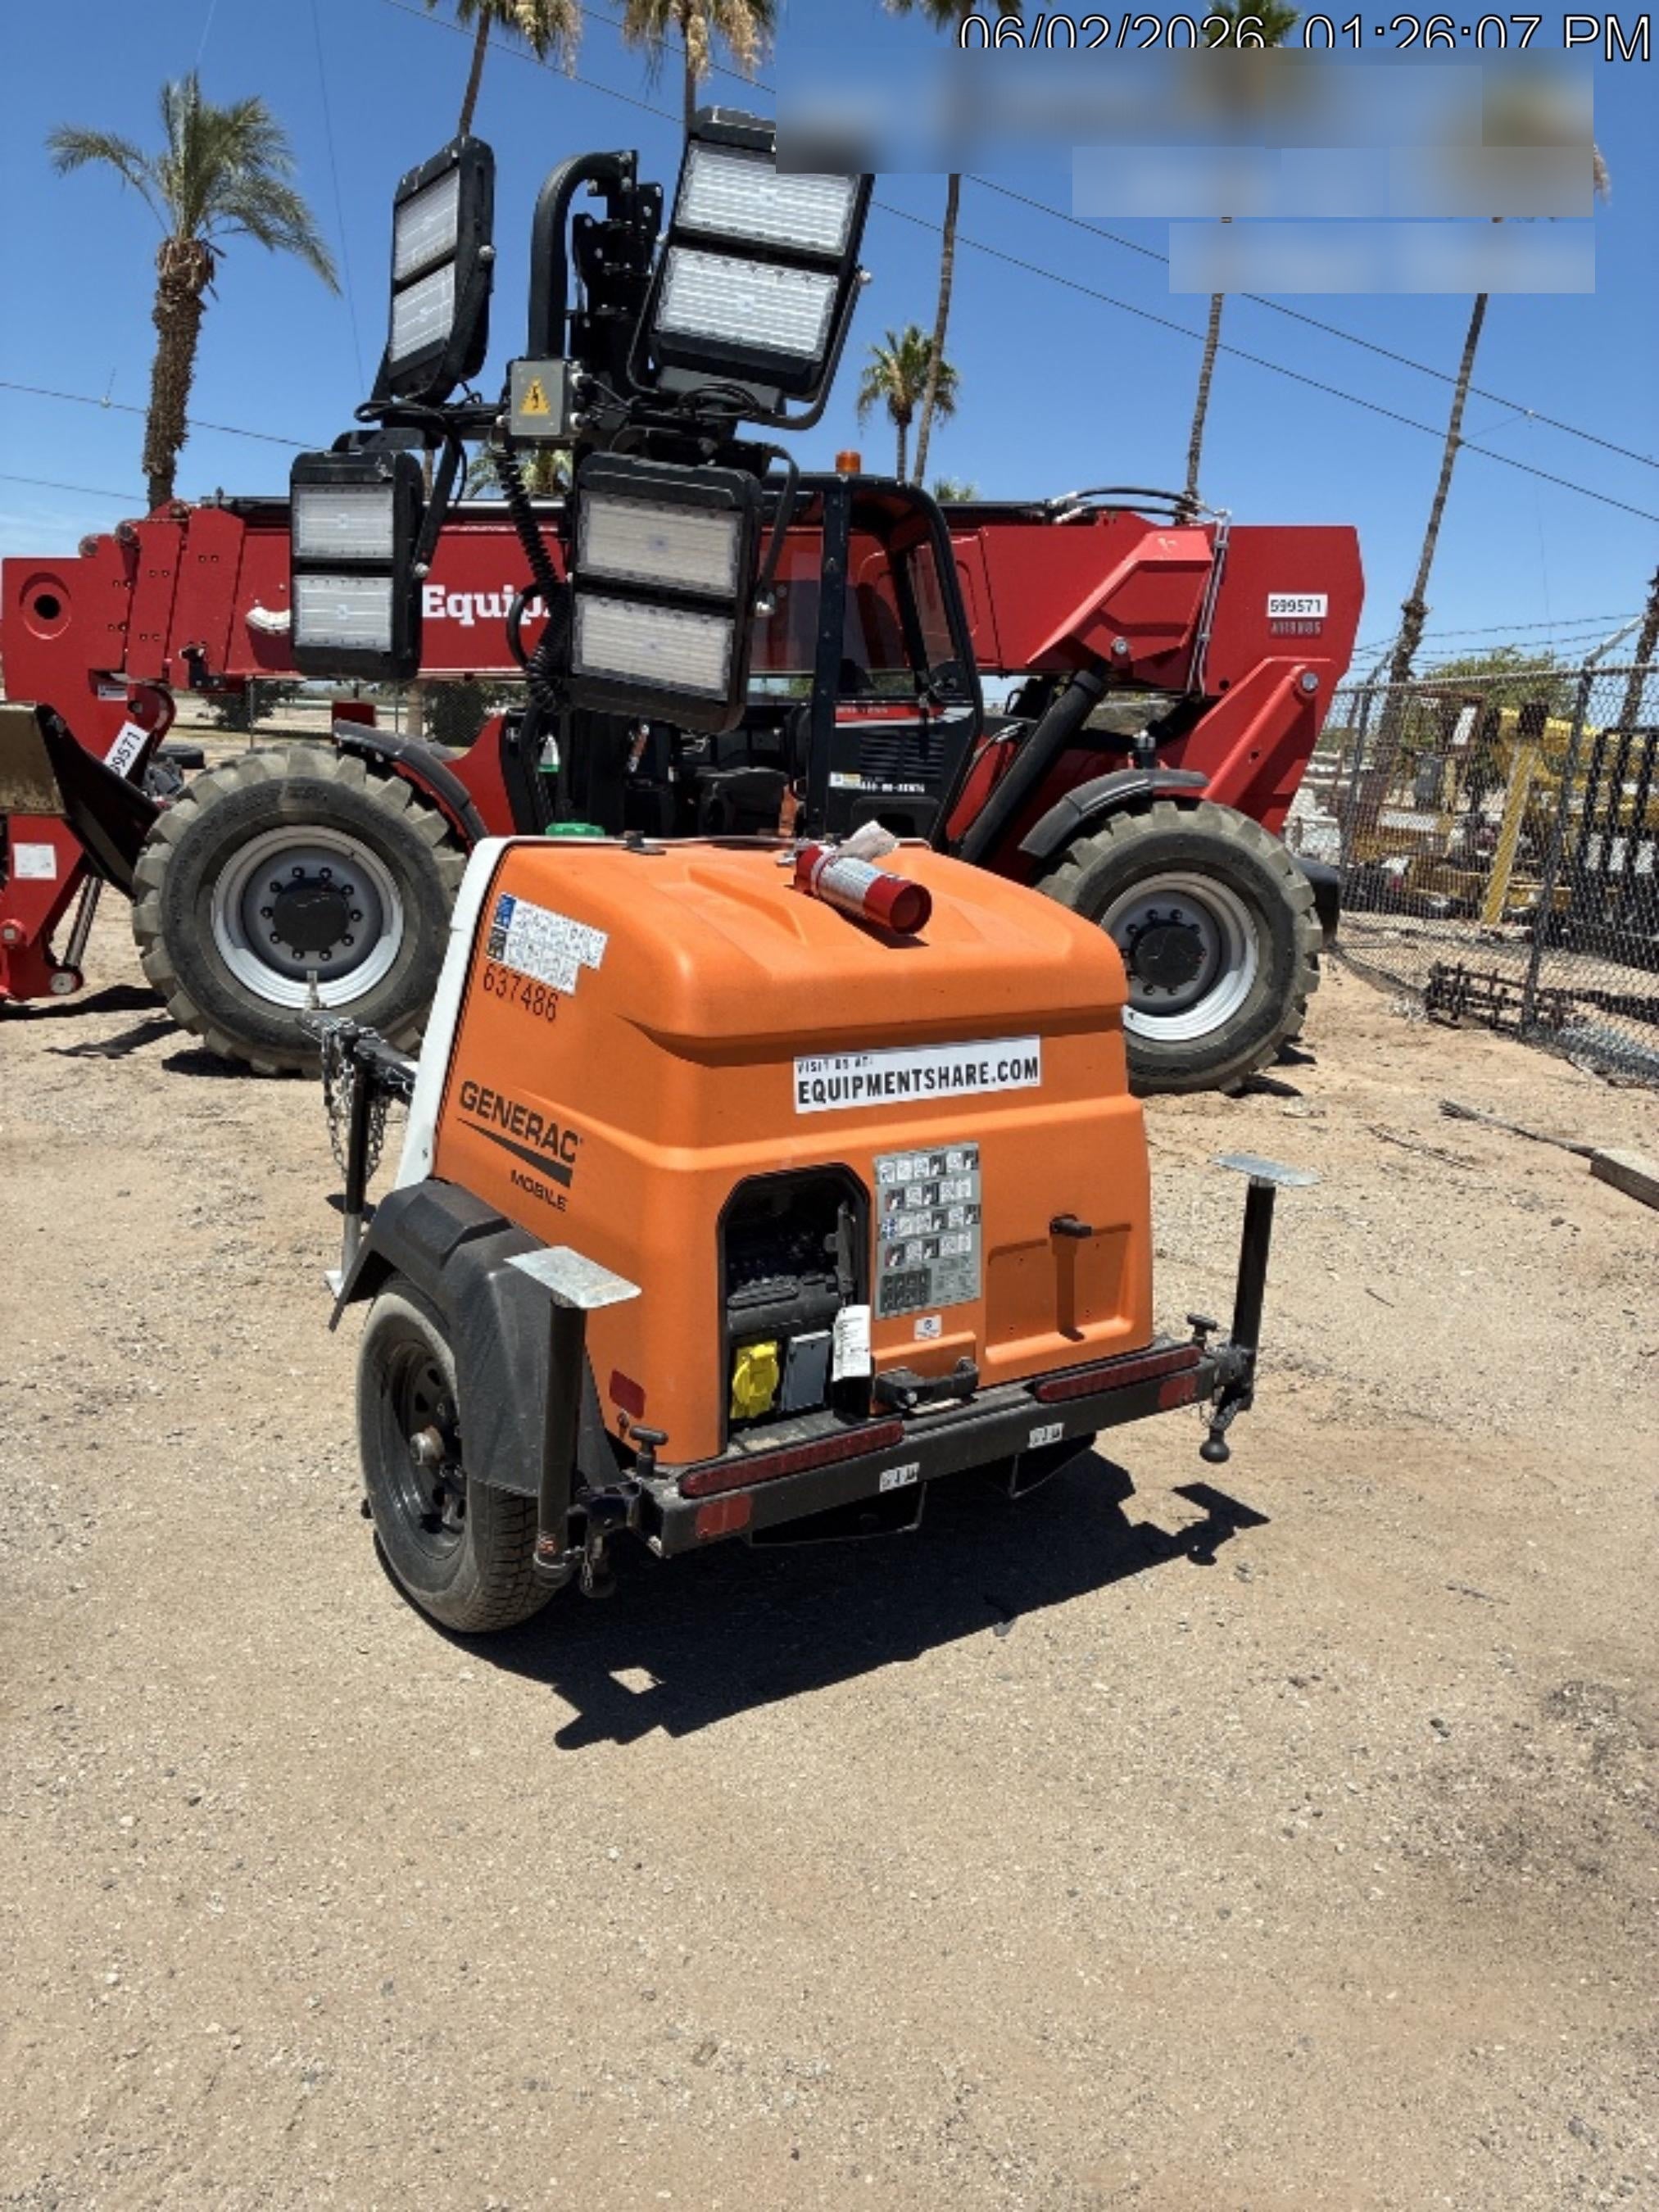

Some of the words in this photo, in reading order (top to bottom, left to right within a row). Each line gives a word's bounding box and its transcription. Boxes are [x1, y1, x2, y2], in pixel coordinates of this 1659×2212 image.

[422, 584, 551, 626] Equip
[1270, 599, 1321, 613] 599571
[483, 963, 559, 1022] 637486
[798, 1058, 829, 1074] VISIT
[798, 1057, 1038, 1104] EQUIPMENTSHARE.COM
[460, 1081, 578, 1163] GENERAC
[510, 1169, 569, 1213] MOBILE
